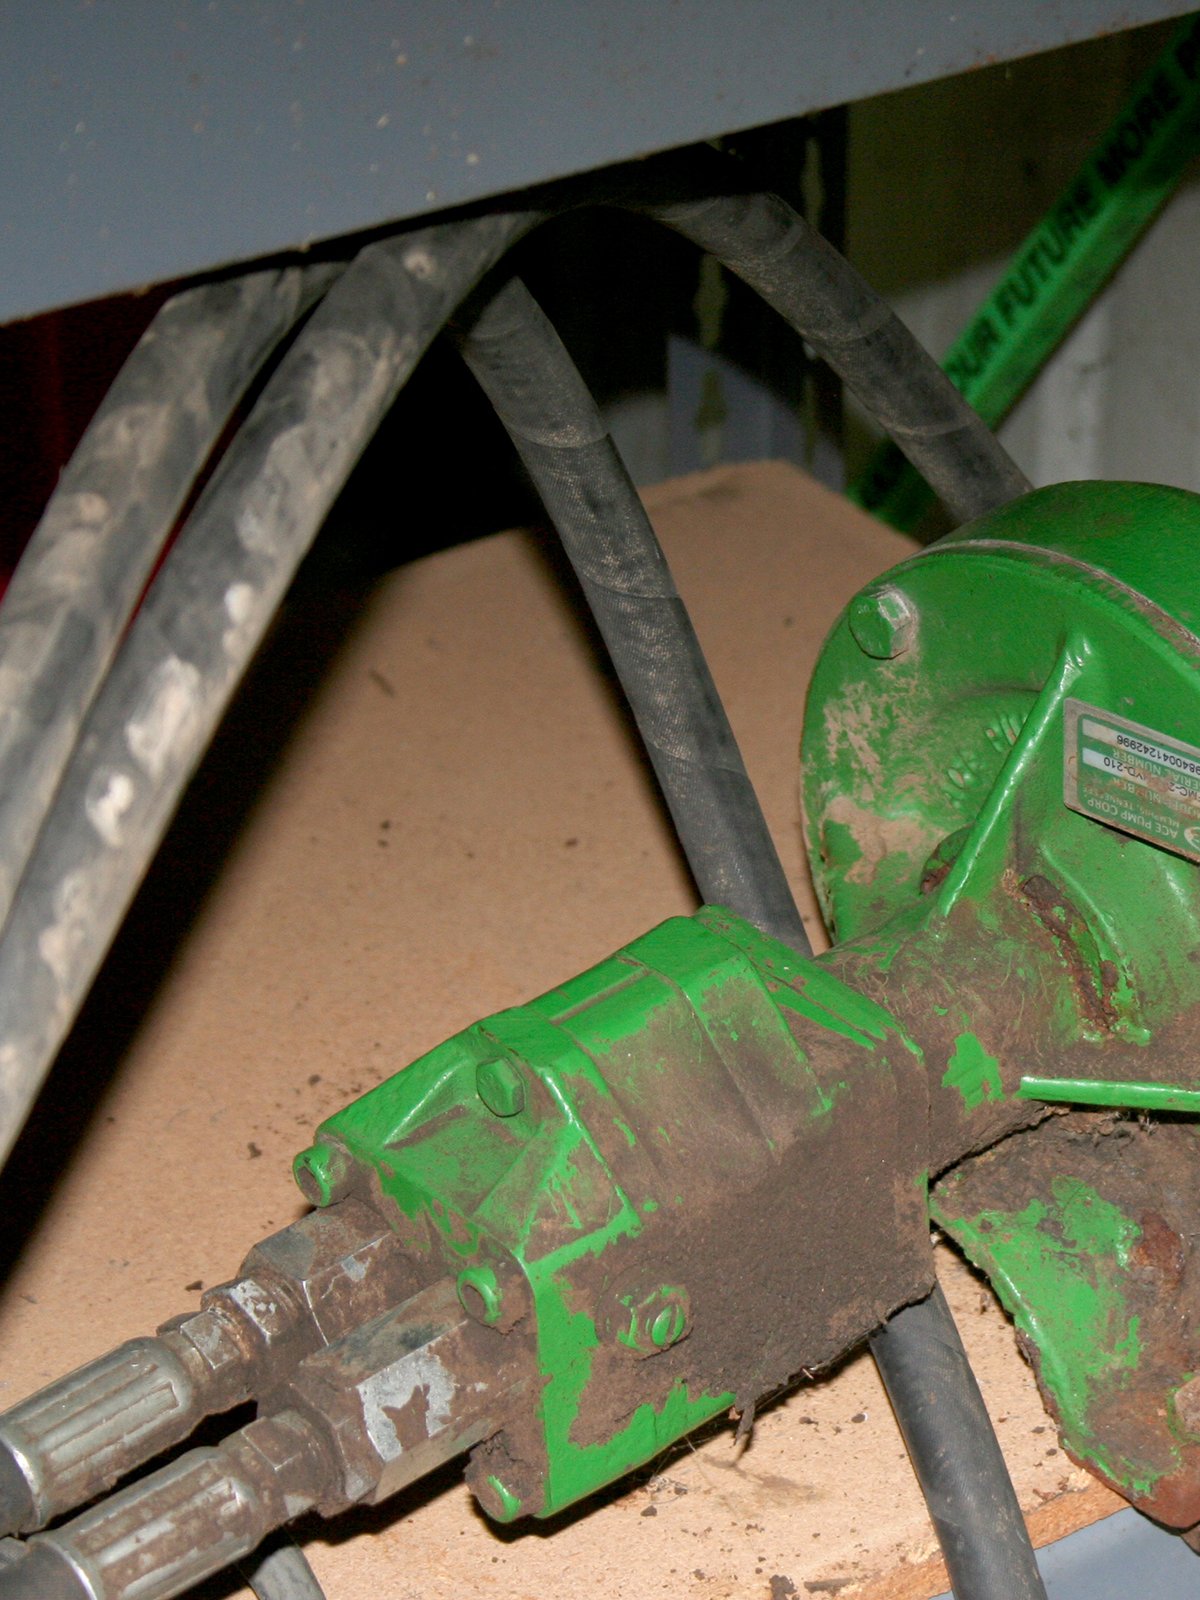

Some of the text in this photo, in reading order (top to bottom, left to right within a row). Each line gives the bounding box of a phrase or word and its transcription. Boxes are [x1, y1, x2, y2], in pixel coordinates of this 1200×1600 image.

[994, 177, 1101, 328] FUTURE
[1095, 71, 1181, 189] MORE
[1110, 747, 1163, 775] NUMBER
[1120, 809, 1154, 829] PUMP
[1153, 821, 1178, 839] ACE
